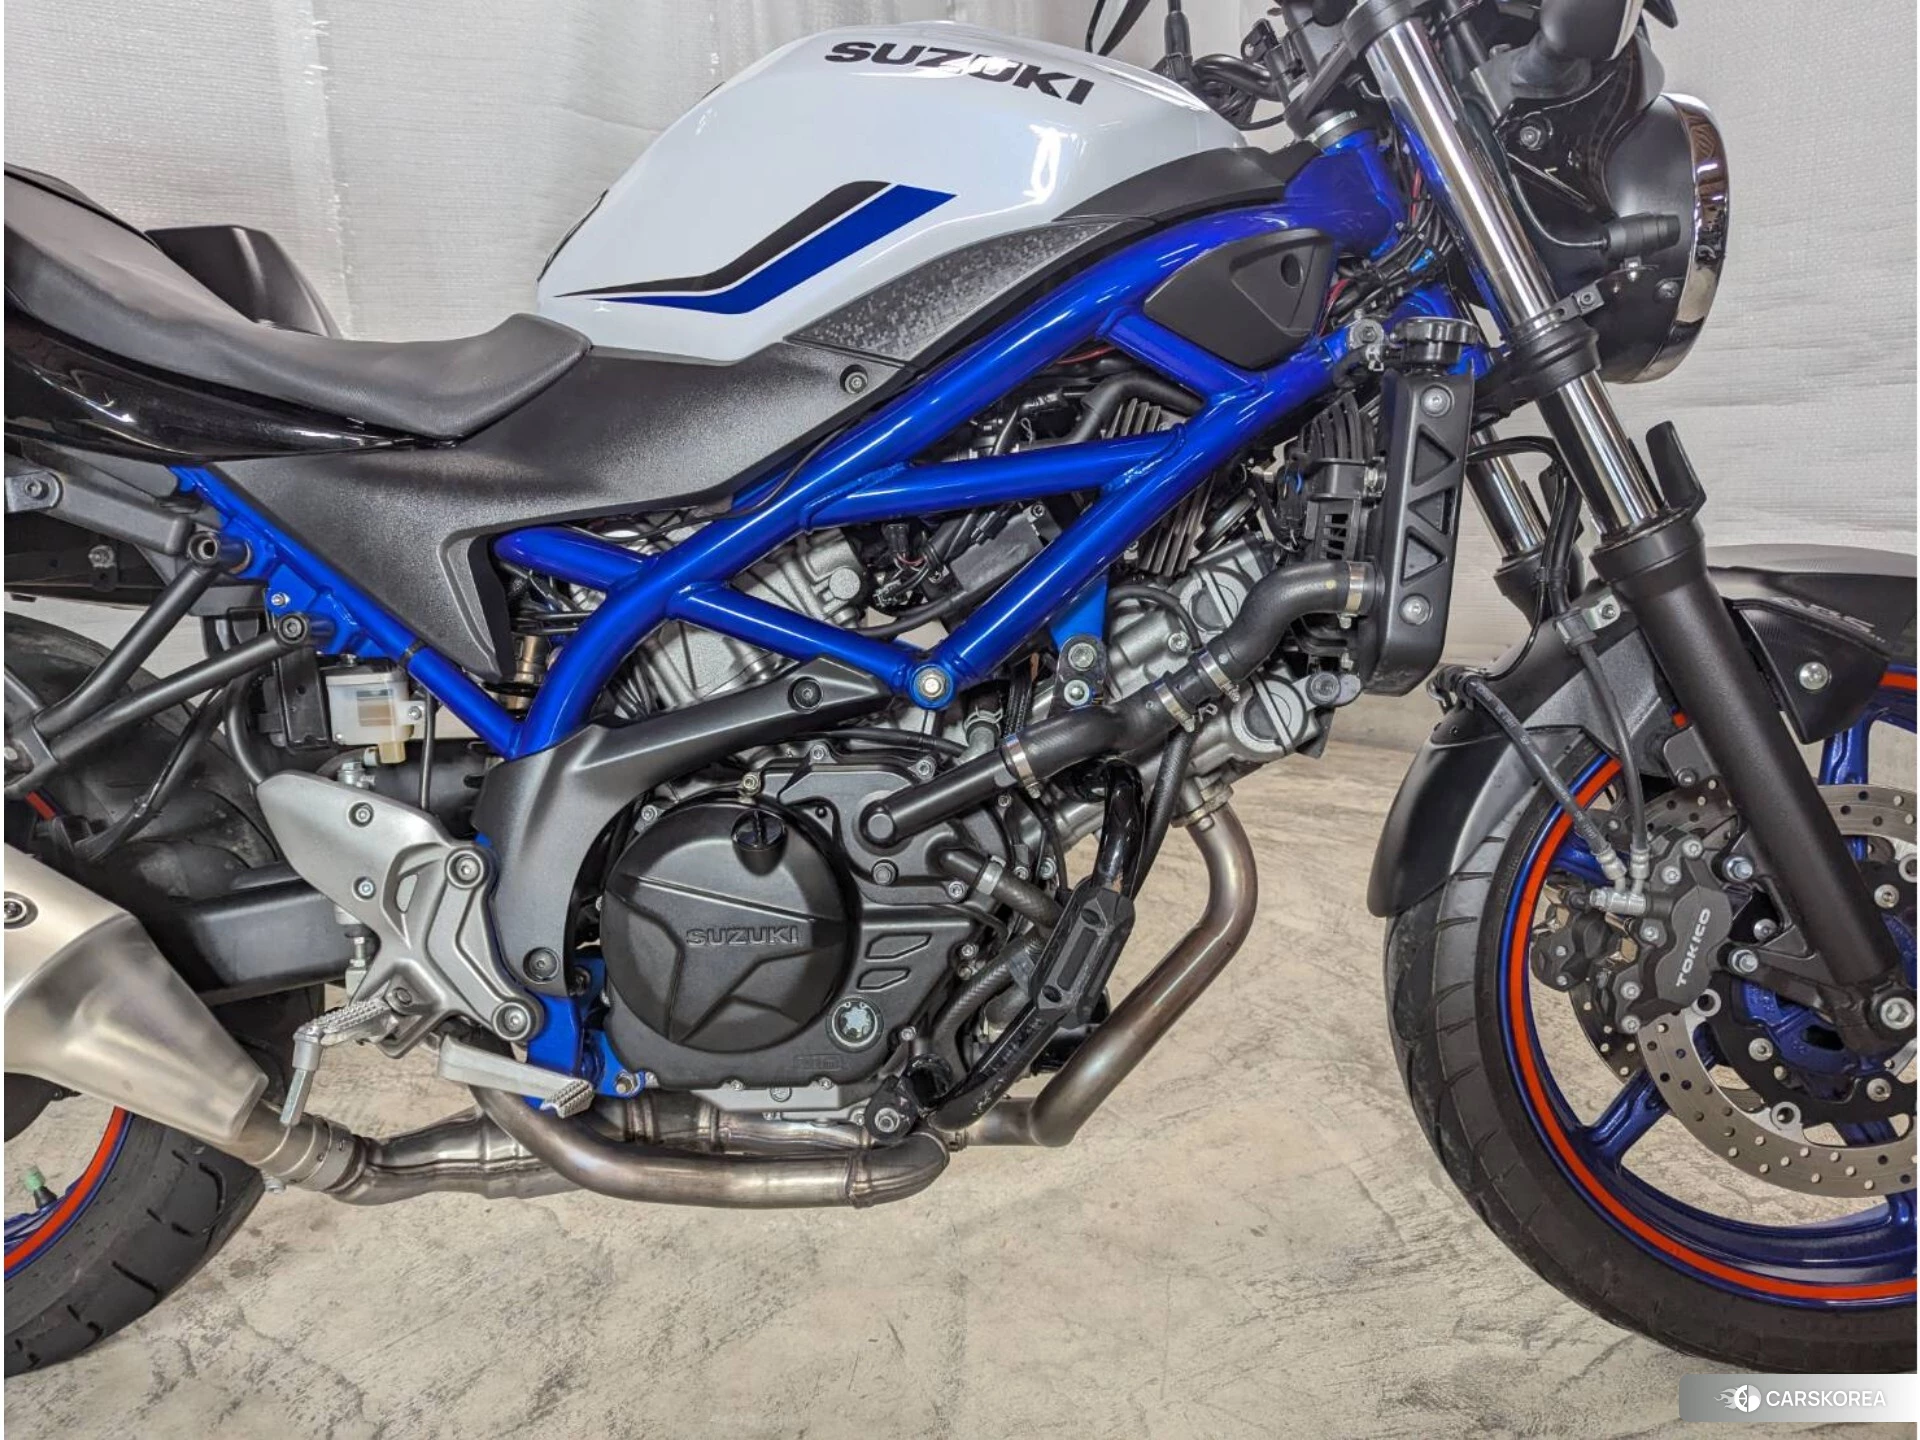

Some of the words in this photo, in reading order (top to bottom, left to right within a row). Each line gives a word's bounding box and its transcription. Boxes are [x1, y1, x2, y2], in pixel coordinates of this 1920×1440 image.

[825, 41, 1095, 105] SUZUKI
[686, 925, 799, 946] SUZUKI
[1675, 907, 1711, 987] TOKICO
